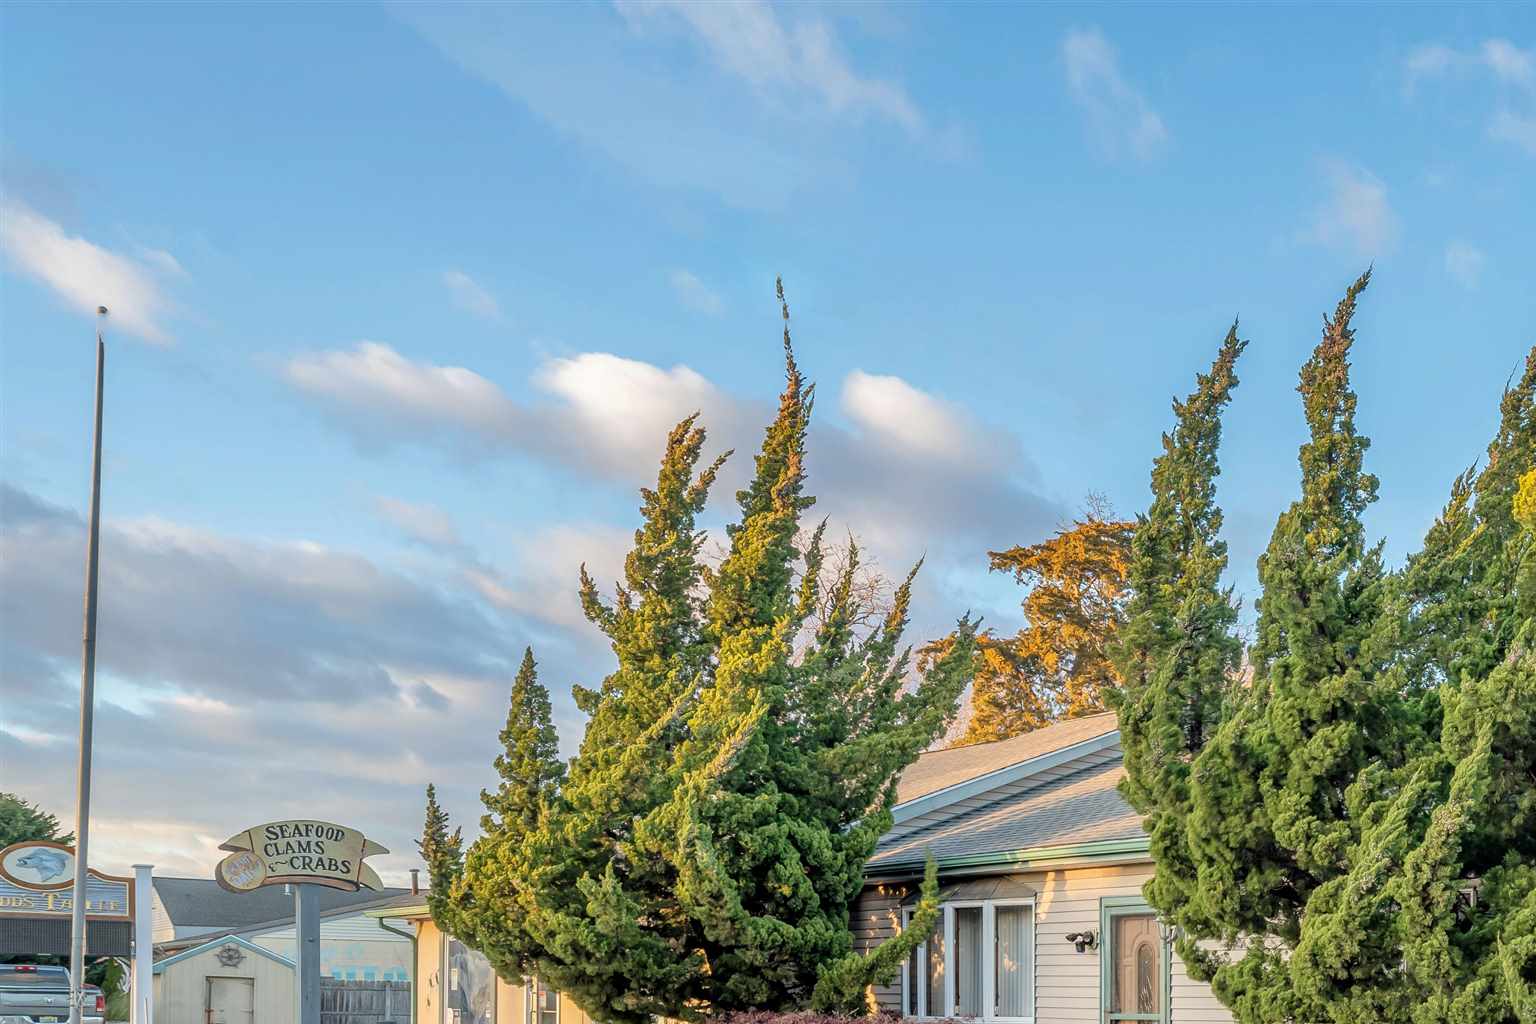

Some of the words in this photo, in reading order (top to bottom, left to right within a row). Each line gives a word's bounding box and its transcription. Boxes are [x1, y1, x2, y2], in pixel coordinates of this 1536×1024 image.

[264, 823, 345, 842] SEAFOOD
[263, 840, 325, 857] CLAMS
[289, 855, 352, 875] CRABS
